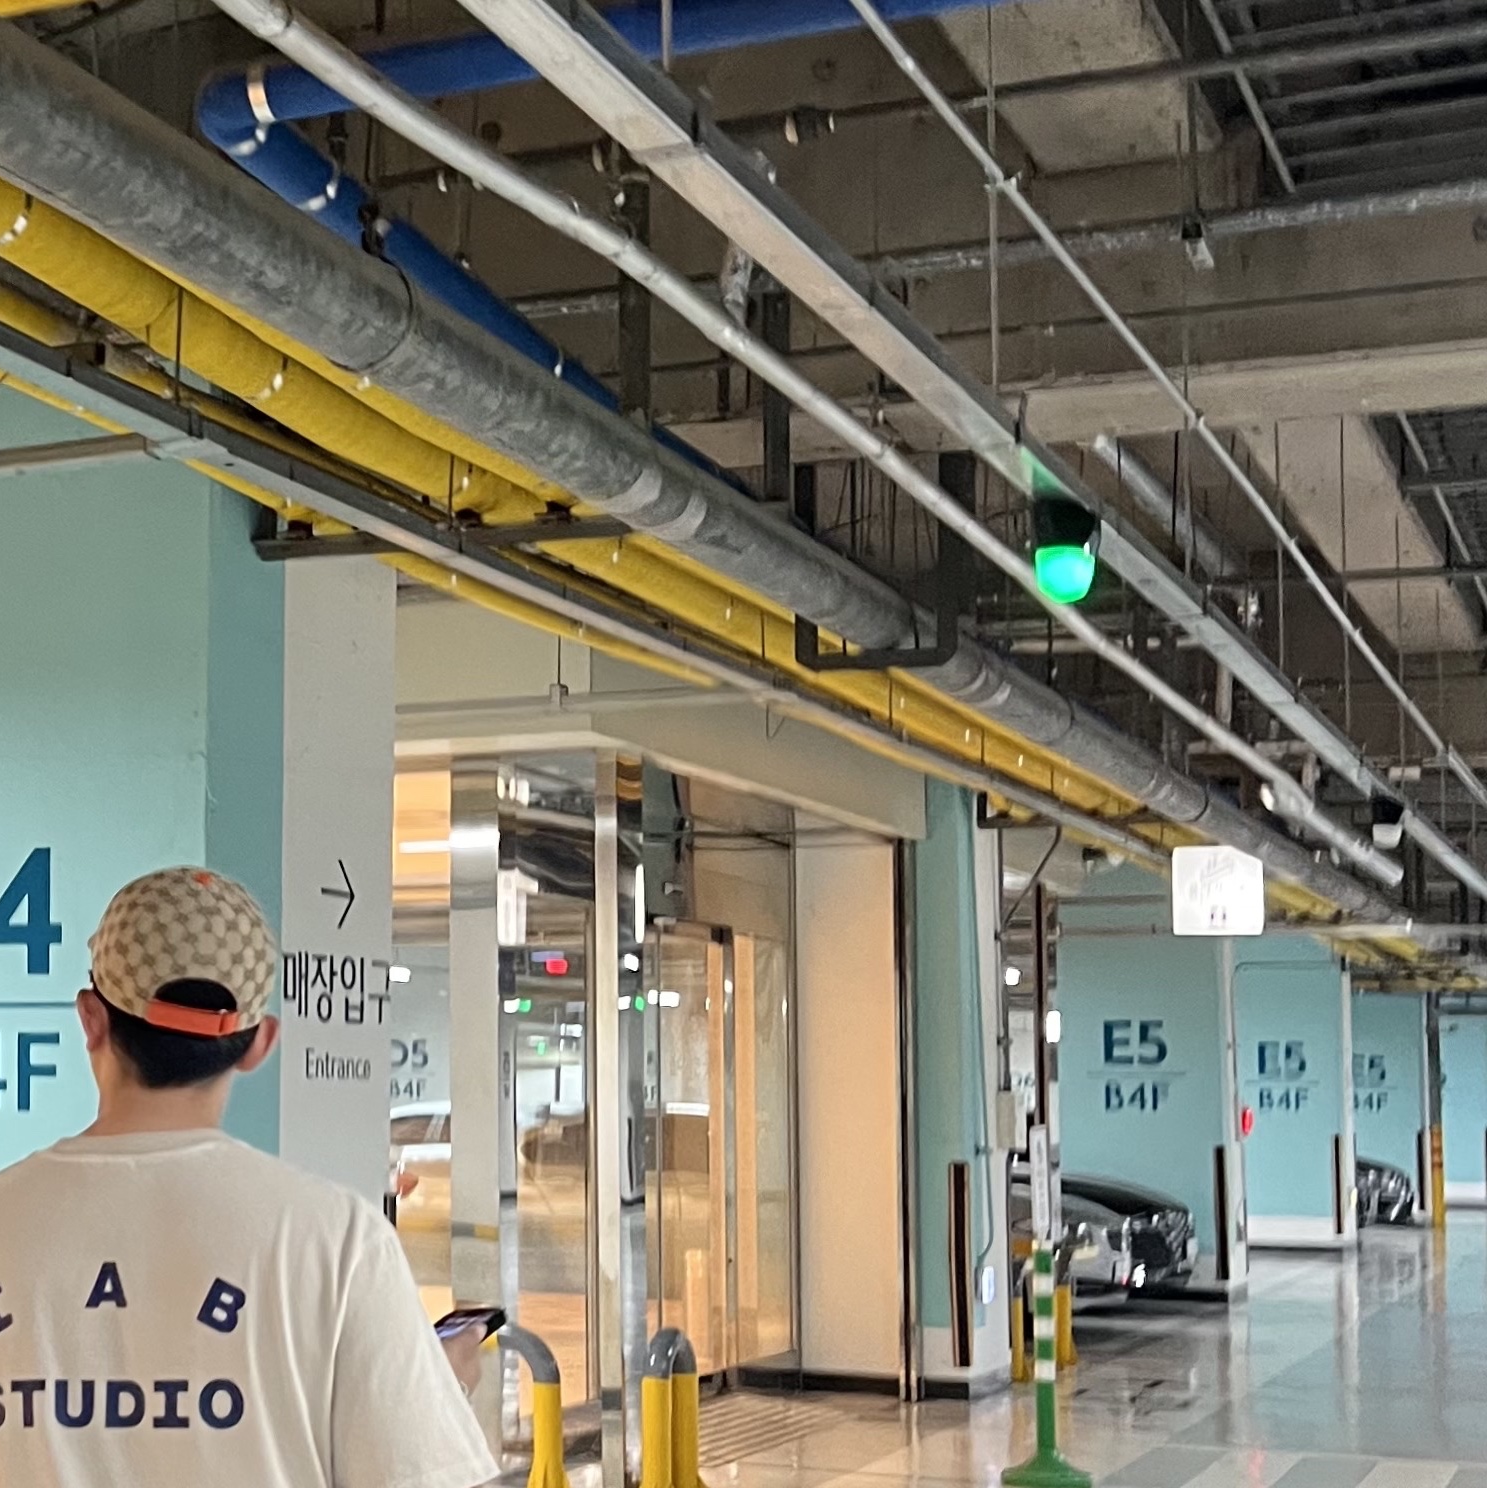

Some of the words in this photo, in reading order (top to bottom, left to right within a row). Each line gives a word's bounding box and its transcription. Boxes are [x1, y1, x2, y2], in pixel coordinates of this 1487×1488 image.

[283, 950, 392, 1026] 매장입구
[1103, 1019, 1167, 1065] E5
[305, 1047, 372, 1081] Entrance
[1104, 1081, 1170, 1112] B4F
